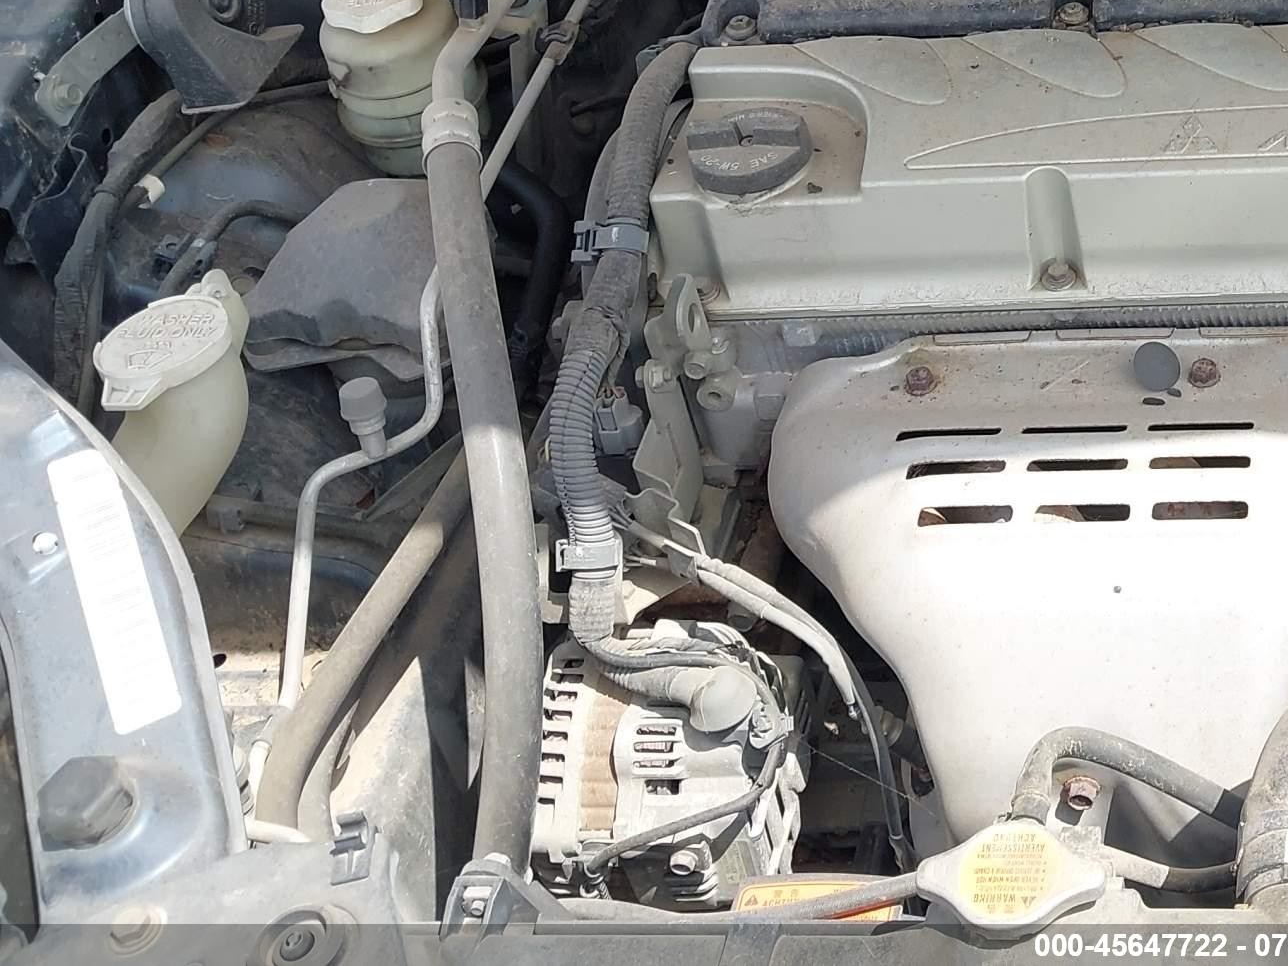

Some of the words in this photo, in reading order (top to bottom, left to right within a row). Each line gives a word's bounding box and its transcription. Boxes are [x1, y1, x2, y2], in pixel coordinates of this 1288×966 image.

[700, 154, 740, 171] 5W-20
[750, 152, 778, 168] SAE
[140, 313, 216, 327] WASHER
[116, 328, 171, 339] FLUID
[171, 326, 217, 338] ONLY
[973, 893, 1016, 903] WARNING
